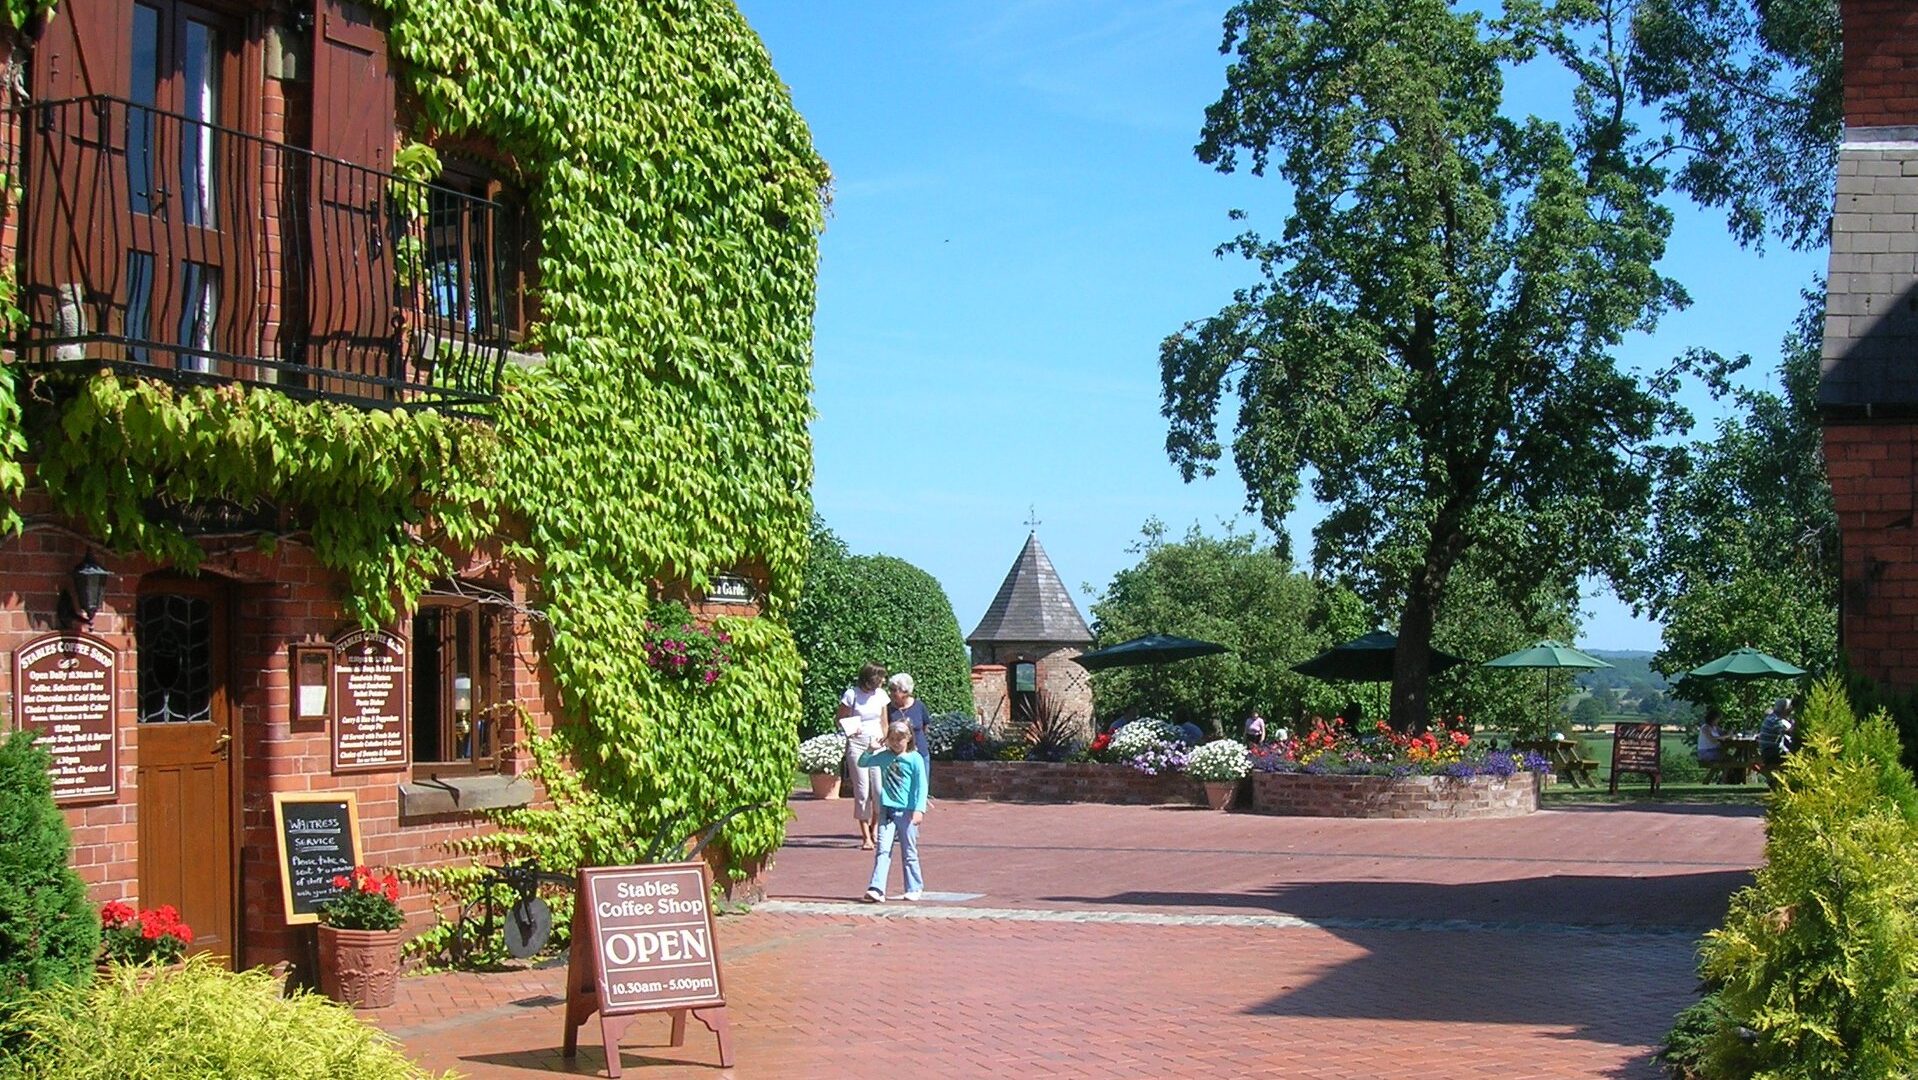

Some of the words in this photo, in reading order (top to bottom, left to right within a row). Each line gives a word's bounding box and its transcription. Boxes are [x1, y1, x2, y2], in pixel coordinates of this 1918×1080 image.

[21, 643, 57, 669] STABLES
[57, 641, 89, 655] COFFEE
[90, 647, 113, 667] SHOP
[29, 671, 49, 681] Open
[49, 671, 68, 680] Daily
[94, 669, 105, 679] for
[82, 683, 90, 691] of
[23, 695, 36, 703] Hot
[36, 694, 67, 703] Chocolate
[67, 694, 73, 702] &
[74, 694, 89, 702] Cold
[89, 693, 111, 701] Drinks
[25, 706, 46, 714] Choice
[47, 705, 55, 713] of
[55, 704, 89, 713] Homemade
[89, 703, 109, 711] Cakes
[74, 733, 87, 742] Roll
[87, 732, 93, 741] &
[93, 732, 112, 741] Butter
[51, 745, 76, 754] Lunches
[77, 766, 99, 774] Choice
[99, 764, 107, 772] of
[295, 837, 336, 846] SERVICE
[292, 855, 318, 866] Please
[295, 867, 314, 876] seat
[296, 877, 305, 887] of
[616, 880, 680, 899] Stables
[598, 901, 655, 918] Coffee
[657, 898, 703, 916] Shop
[606, 929, 708, 965] OPEN
